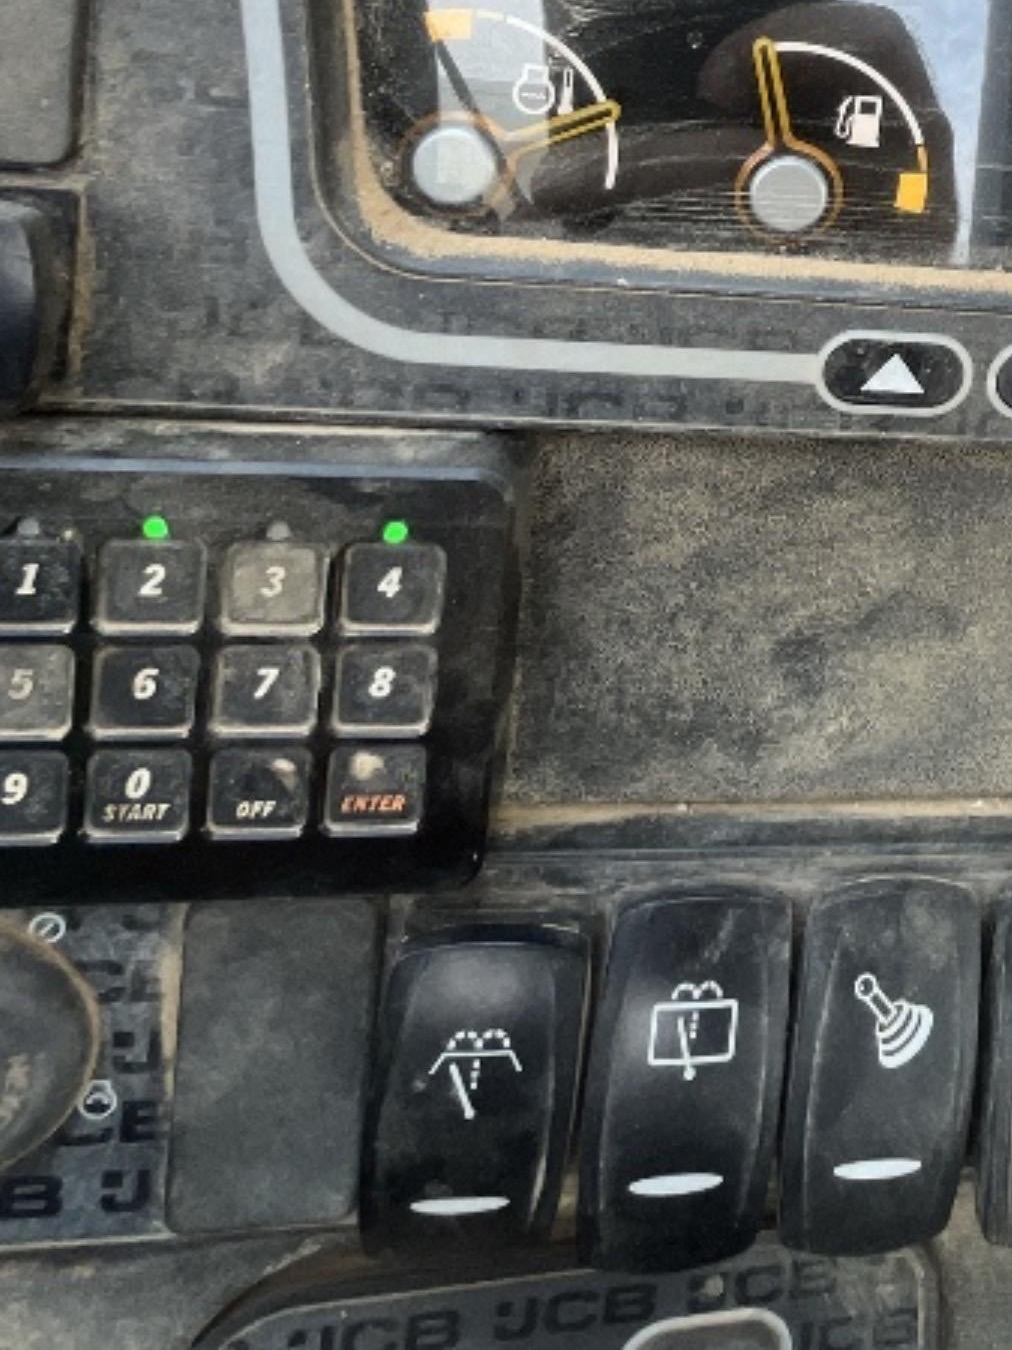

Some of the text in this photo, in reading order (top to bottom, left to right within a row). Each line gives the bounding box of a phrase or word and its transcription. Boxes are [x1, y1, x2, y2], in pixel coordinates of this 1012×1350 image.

[15, 564, 40, 596] 1
[138, 564, 167, 598] 2
[260, 565, 287, 599] 3
[377, 566, 403, 599] 4
[9, 669, 34, 699] 5
[132, 668, 159, 700] 6
[252, 667, 280, 700] 7
[368, 666, 397, 698] 8
[1, 771, 28, 806] 9
[125, 767, 151, 799] 0
[102, 801, 171, 822] START
[235, 799, 277, 819] OFF
[340, 794, 407, 813] ENTER
[493, 1282, 657, 1341] JCB
